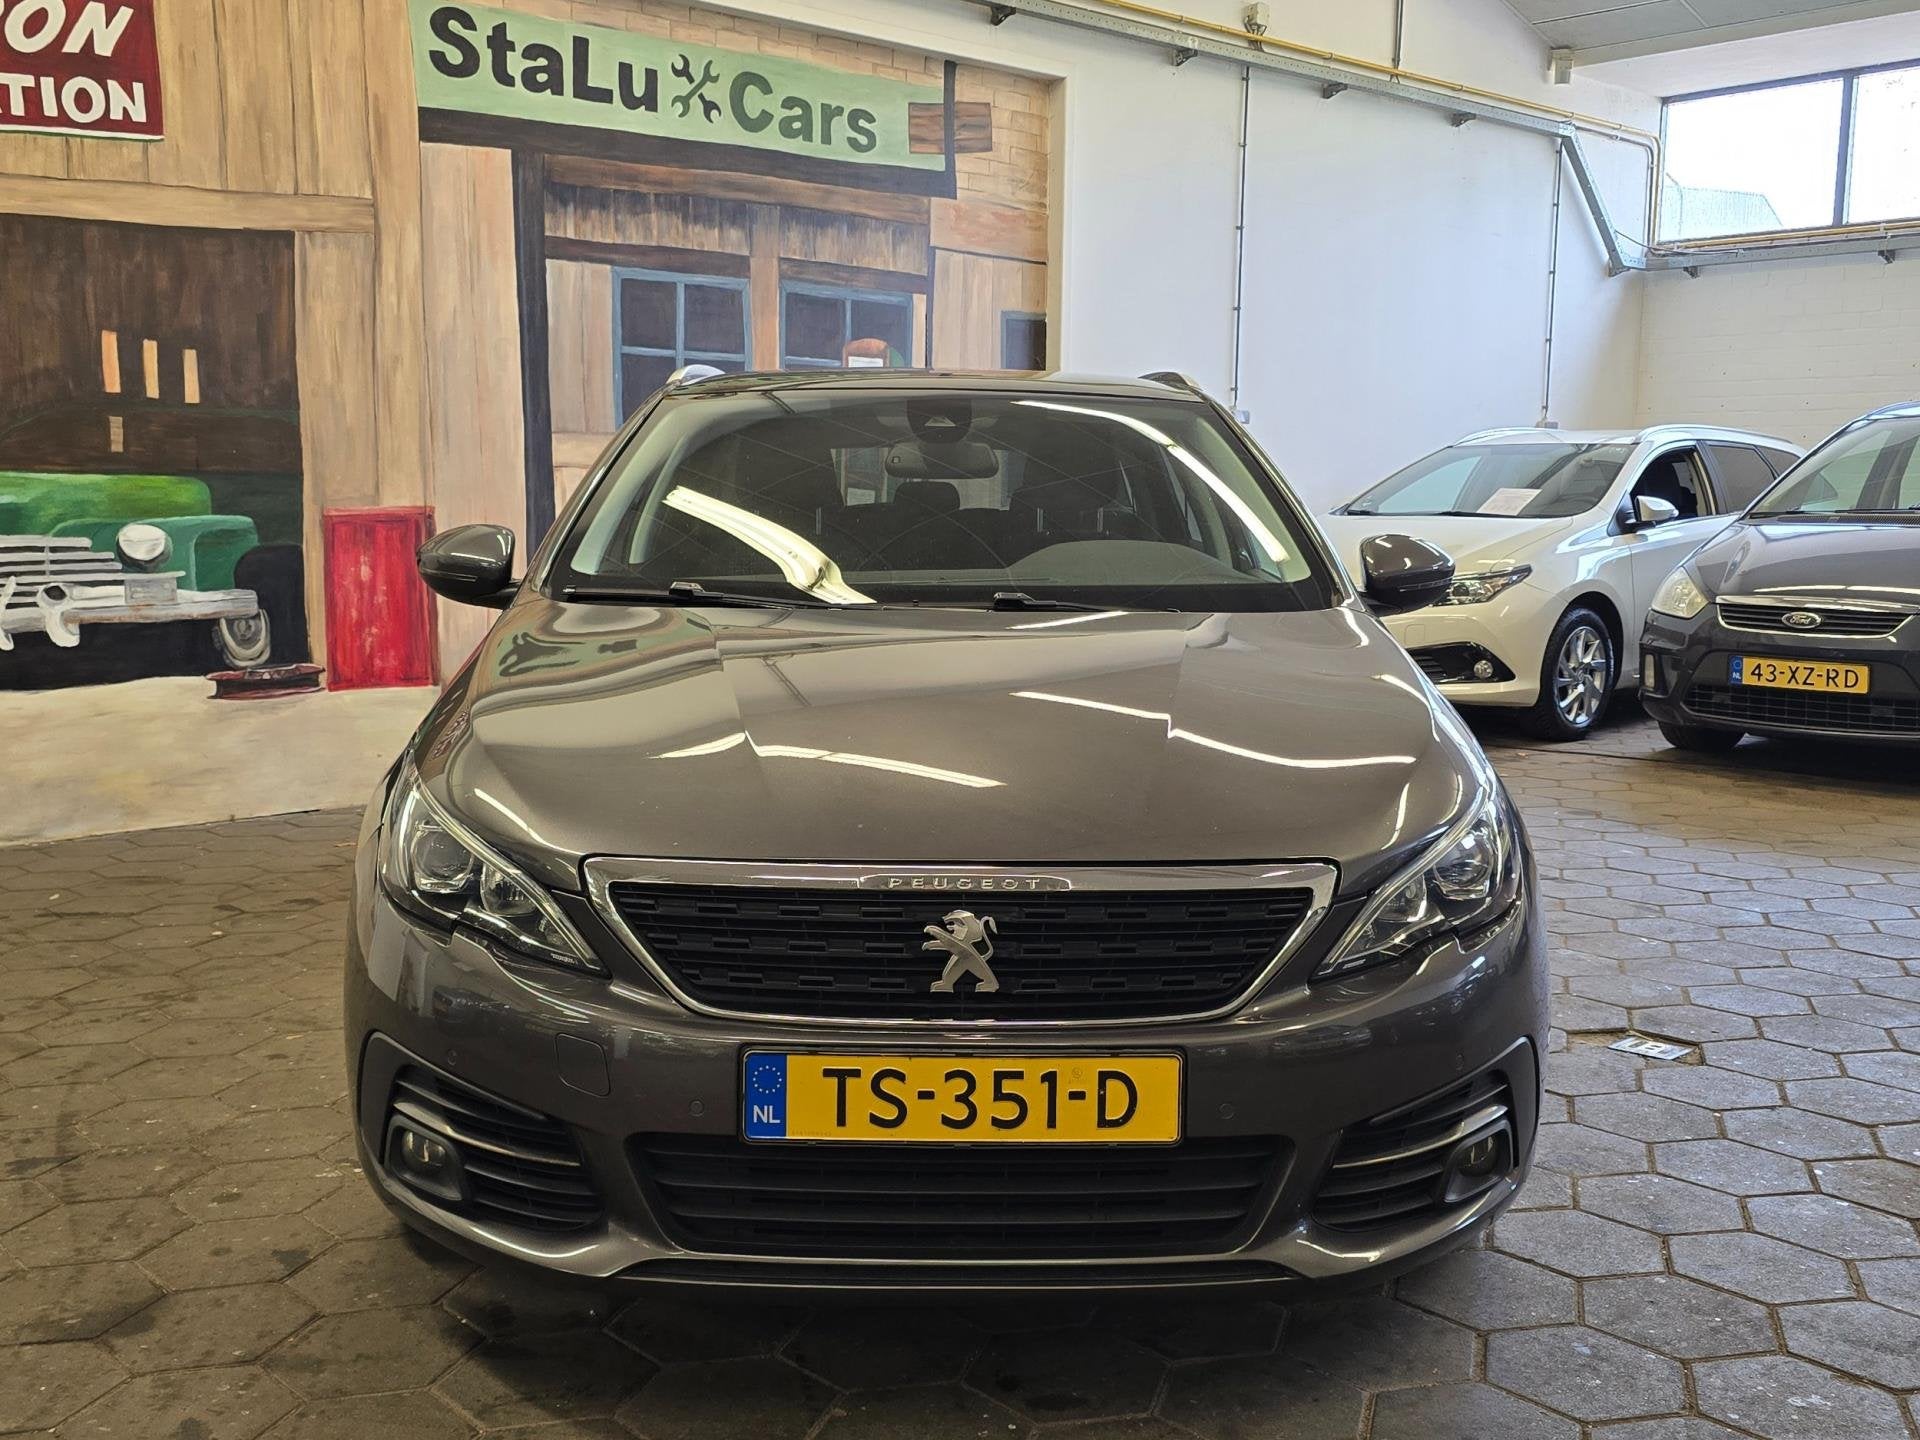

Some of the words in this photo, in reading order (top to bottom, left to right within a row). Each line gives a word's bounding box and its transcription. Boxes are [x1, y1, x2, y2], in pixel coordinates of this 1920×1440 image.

[0, 0, 134, 57] ON
[0, 72, 147, 123] TION
[429, 6, 658, 113] StaLu
[729, 71, 877, 153] Cars
[1750, 663, 1859, 688] 43-XZ-RD
[888, 877, 1040, 890] PEUGEOT
[753, 1105, 780, 1123] NL
[822, 1068, 1138, 1129] TS-351-D
